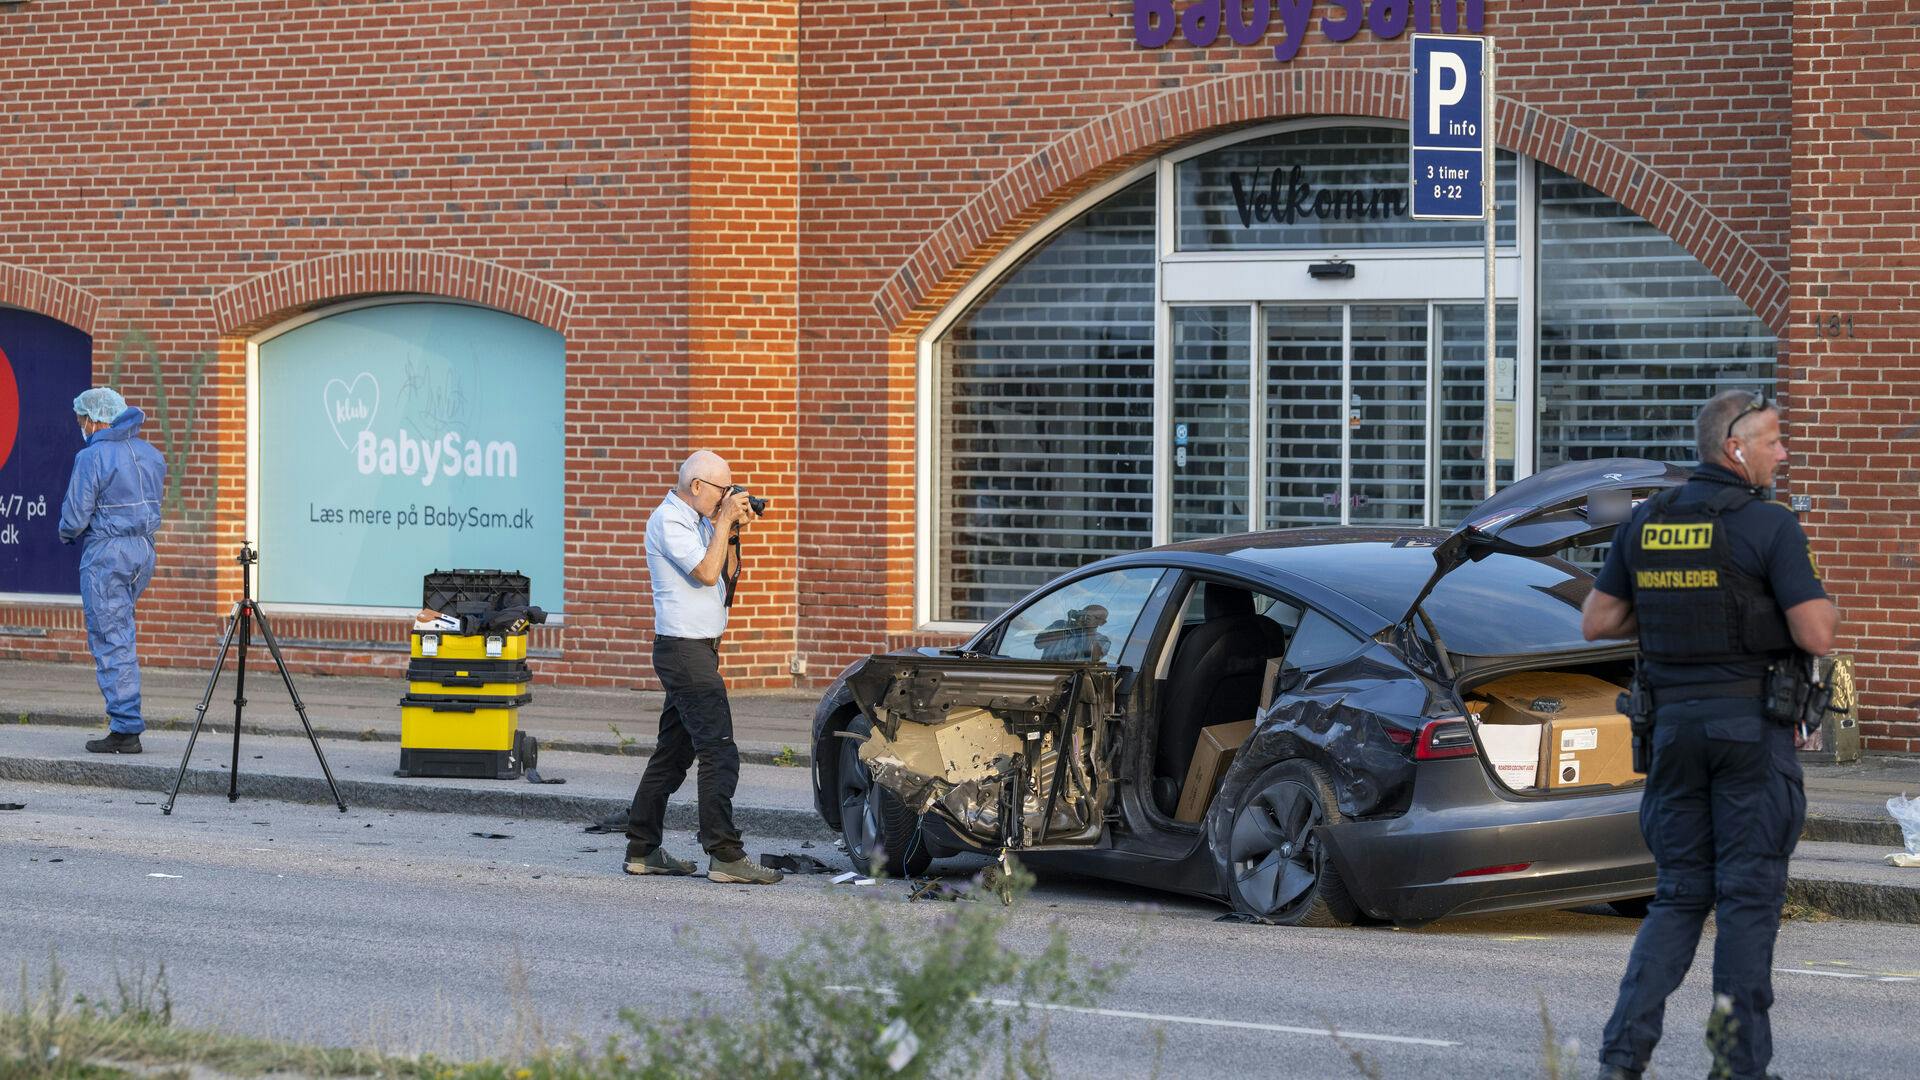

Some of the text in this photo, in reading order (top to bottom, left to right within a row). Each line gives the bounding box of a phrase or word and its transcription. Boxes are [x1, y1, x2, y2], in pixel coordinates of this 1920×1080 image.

[1429, 52, 1476, 136] P info
[1427, 165, 1469, 180] 3 timer
[1230, 162, 1409, 229] Velkomm
[1434, 185, 1462, 199] 8-22
[336, 398, 368, 423] klub
[358, 428, 517, 487] BabySam
[27, 495, 46, 520] på
[310, 503, 534, 532] Læs mere på BabySam.dk
[1644, 528, 1710, 546] POLITI
